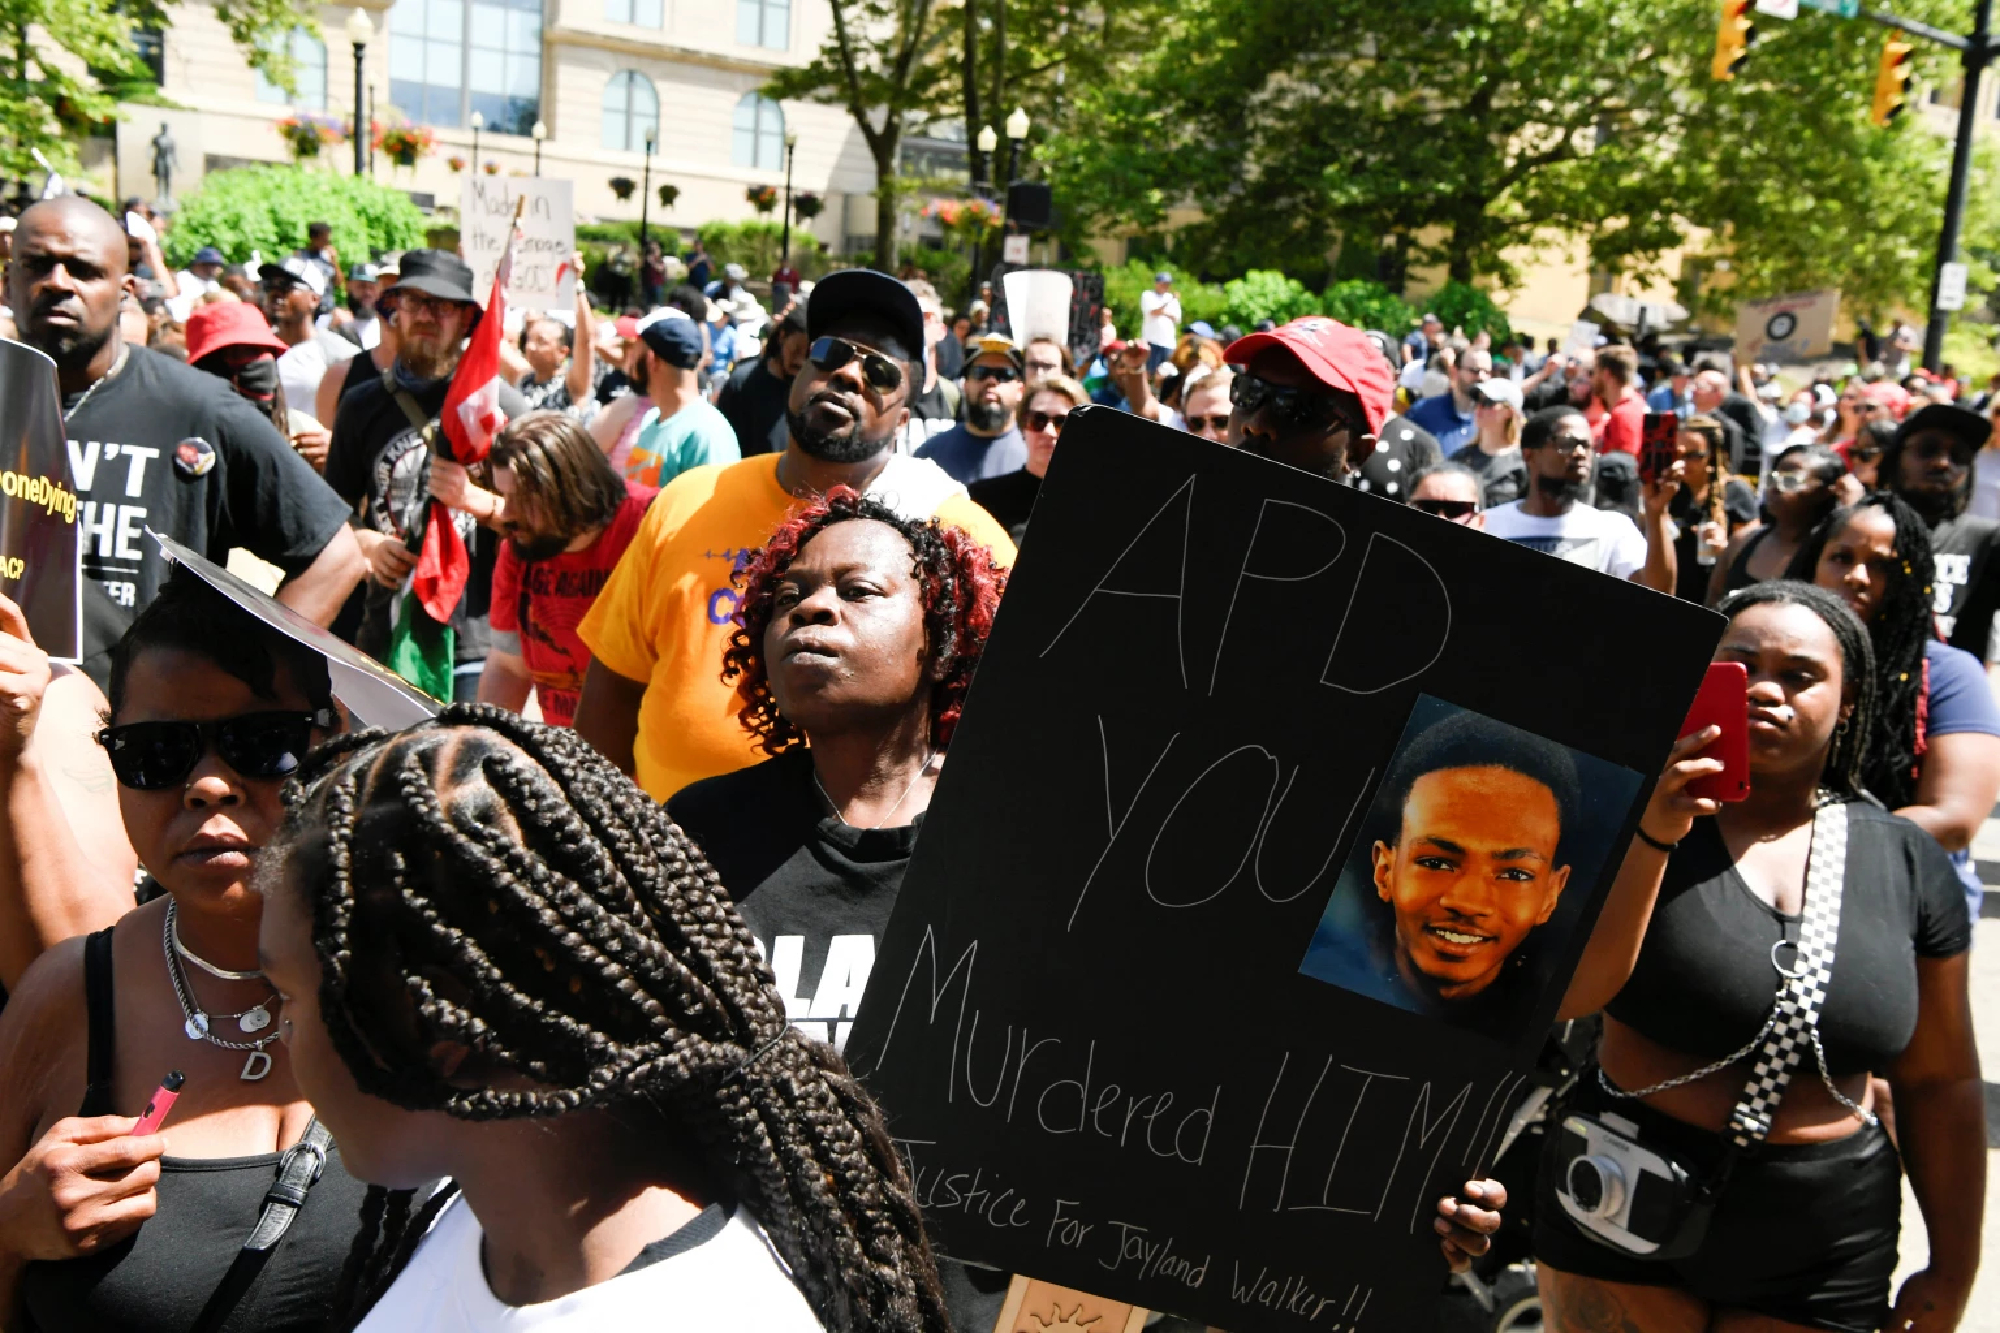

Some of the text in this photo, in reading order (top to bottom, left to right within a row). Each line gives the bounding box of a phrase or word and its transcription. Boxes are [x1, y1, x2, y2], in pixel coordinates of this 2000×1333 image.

[0, 470, 77, 523] oneDying
[1039, 473, 1452, 696] APD
[1067, 714, 1375, 932] YOU
[240, 1051, 271, 1080] D
[753, 934, 875, 1019] LA
[876, 923, 1221, 1166] Murdered
[889, 1137, 1373, 1333] Justice For Jayland Walker!!
